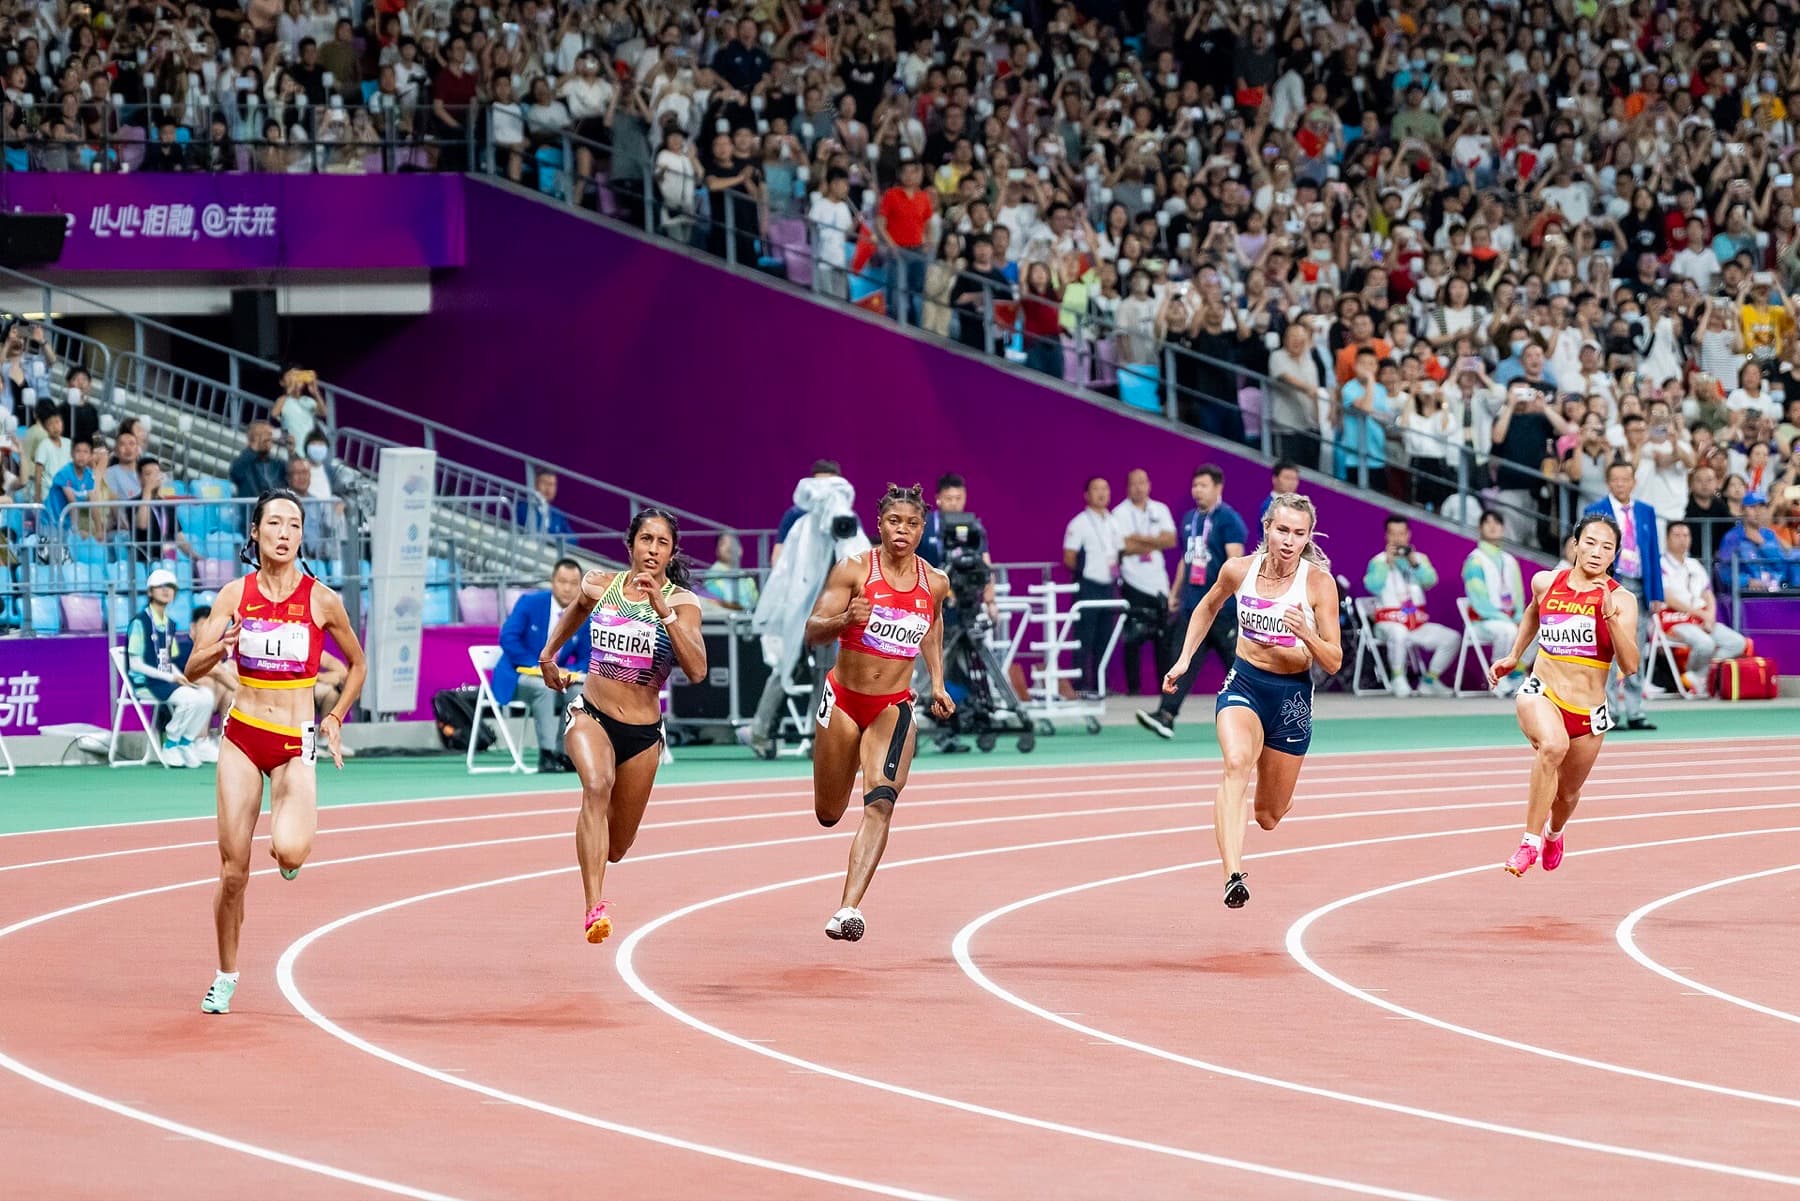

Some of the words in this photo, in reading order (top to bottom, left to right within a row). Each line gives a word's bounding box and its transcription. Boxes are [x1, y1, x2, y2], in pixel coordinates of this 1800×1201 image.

[90, 203, 276, 241] 心心相融,@未来
[1546, 598, 1597, 616] CHINA
[870, 621, 924, 644] ODIONG
[1240, 610, 1292, 634] SAFRONOV
[592, 628, 651, 654] PEREIRA
[1541, 628, 1594, 643] HUANG
[266, 639, 280, 657] LI
[1596, 705, 1608, 731] 3
